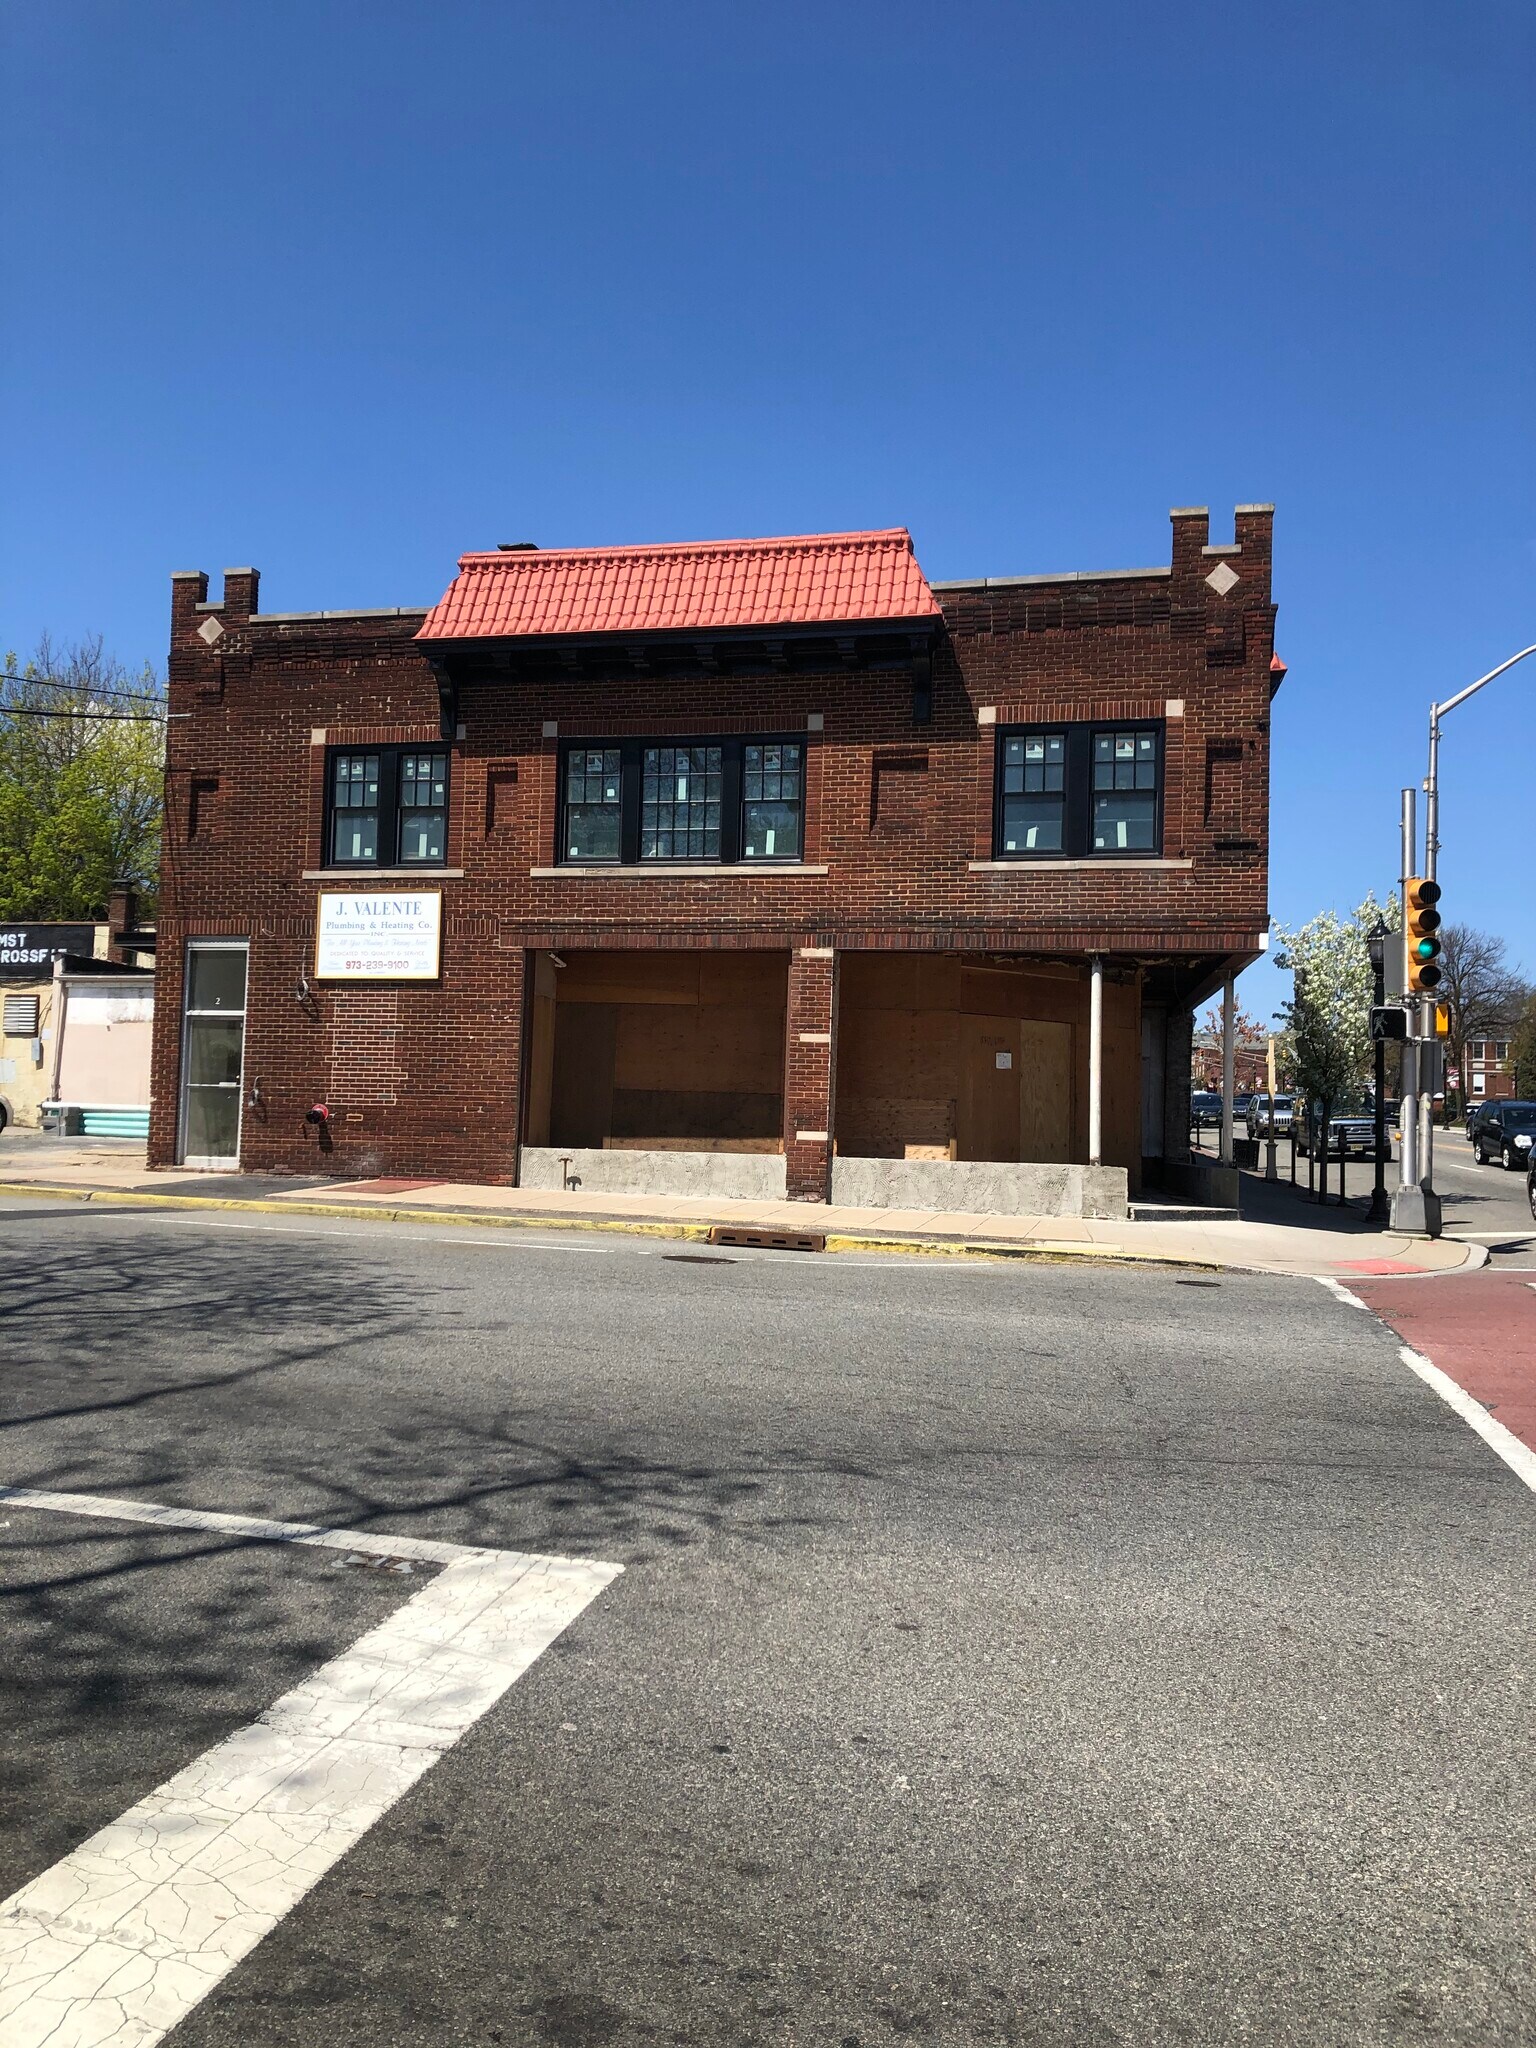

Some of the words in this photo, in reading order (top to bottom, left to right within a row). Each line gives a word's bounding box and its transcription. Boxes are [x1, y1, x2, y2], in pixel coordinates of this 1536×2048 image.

[336, 902, 347, 916] J.
[355, 902, 422, 915] VALENTE
[326, 921, 365, 930] Plumbing
[369, 921, 377, 930] &
[381, 921, 414, 930] Heating
[418, 921, 432, 929] Co.
[1, 949, 67, 963] ROSSFI
[345, 960, 409, 970] 973-239-9100
[215, 997, 220, 1005] 2
